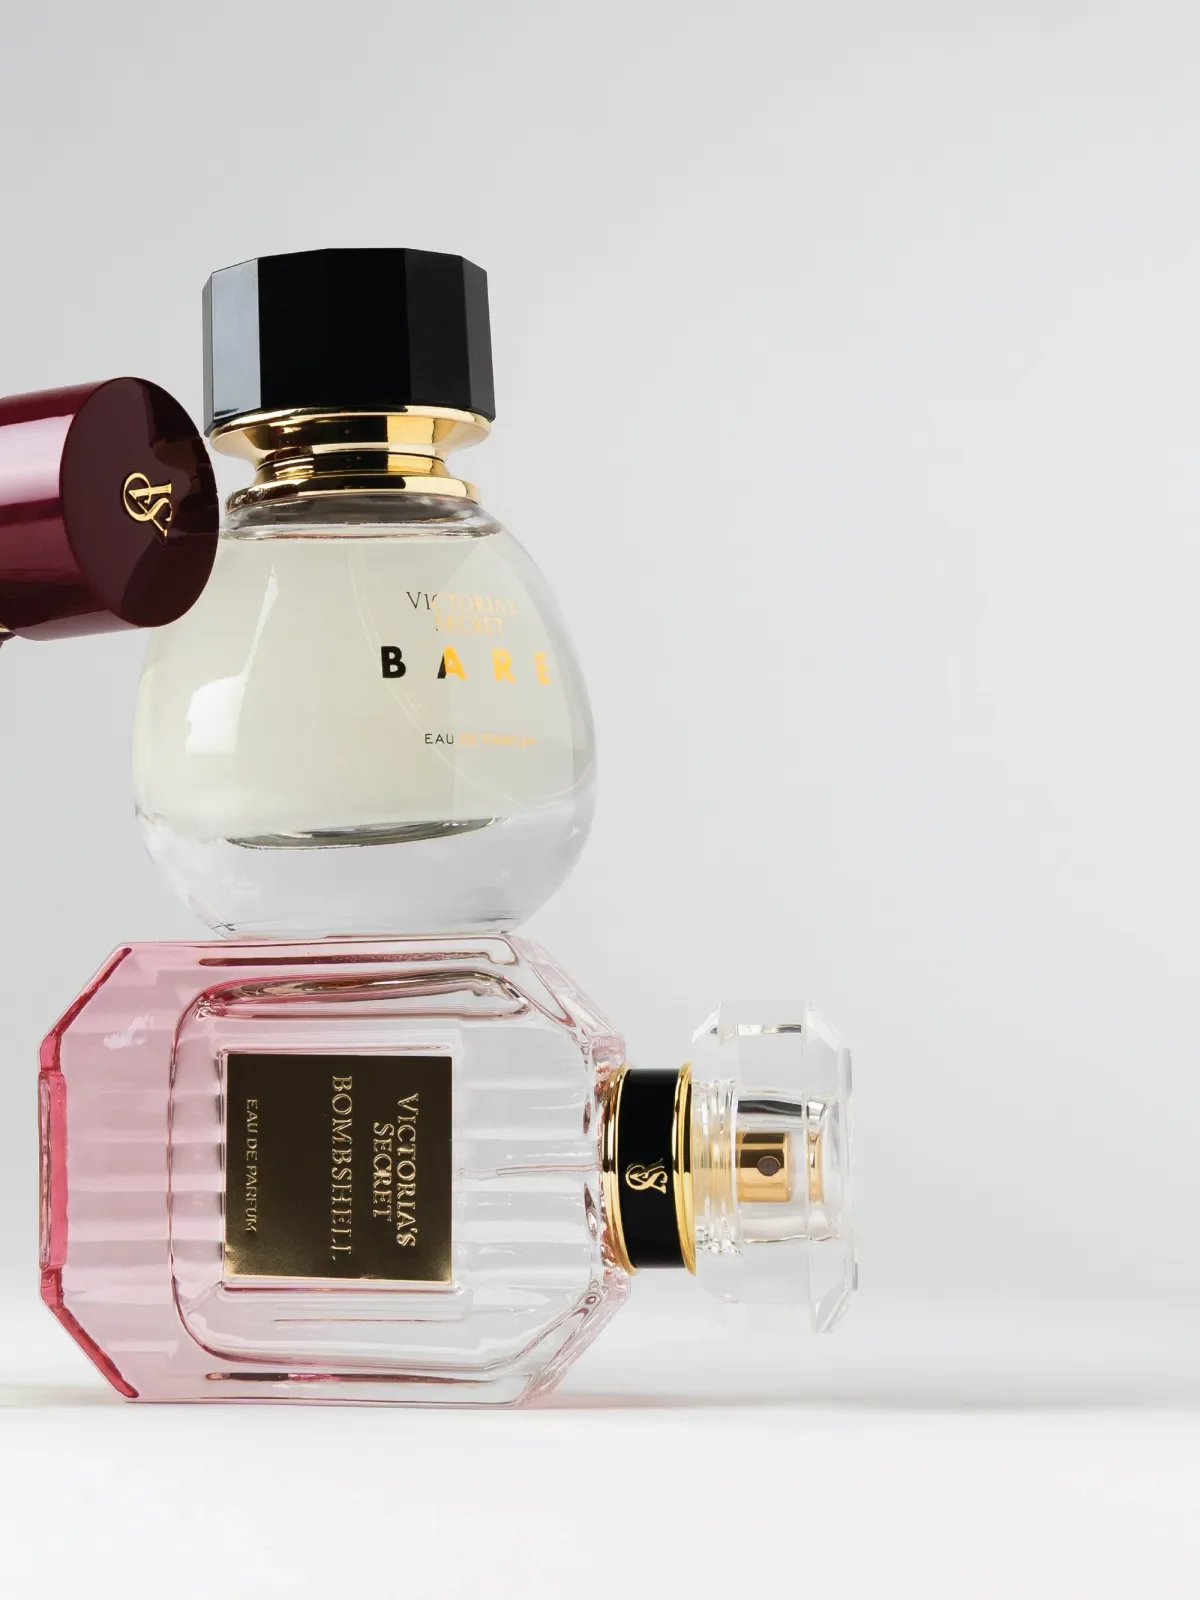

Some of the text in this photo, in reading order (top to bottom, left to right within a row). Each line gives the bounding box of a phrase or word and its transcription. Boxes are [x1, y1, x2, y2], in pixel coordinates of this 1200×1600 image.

[406, 591, 517, 617] VICTORIAS
[433, 610, 505, 637] SECRET
[381, 645, 552, 685] BARE
[424, 733, 454, 745] EAU
[245, 1098, 258, 1232] EAU DE PARFUM
[330, 1075, 353, 1261] BOMBSHELL
[372, 1122, 395, 1222] SECRET
[396, 1092, 419, 1247] VICTORIA'S
